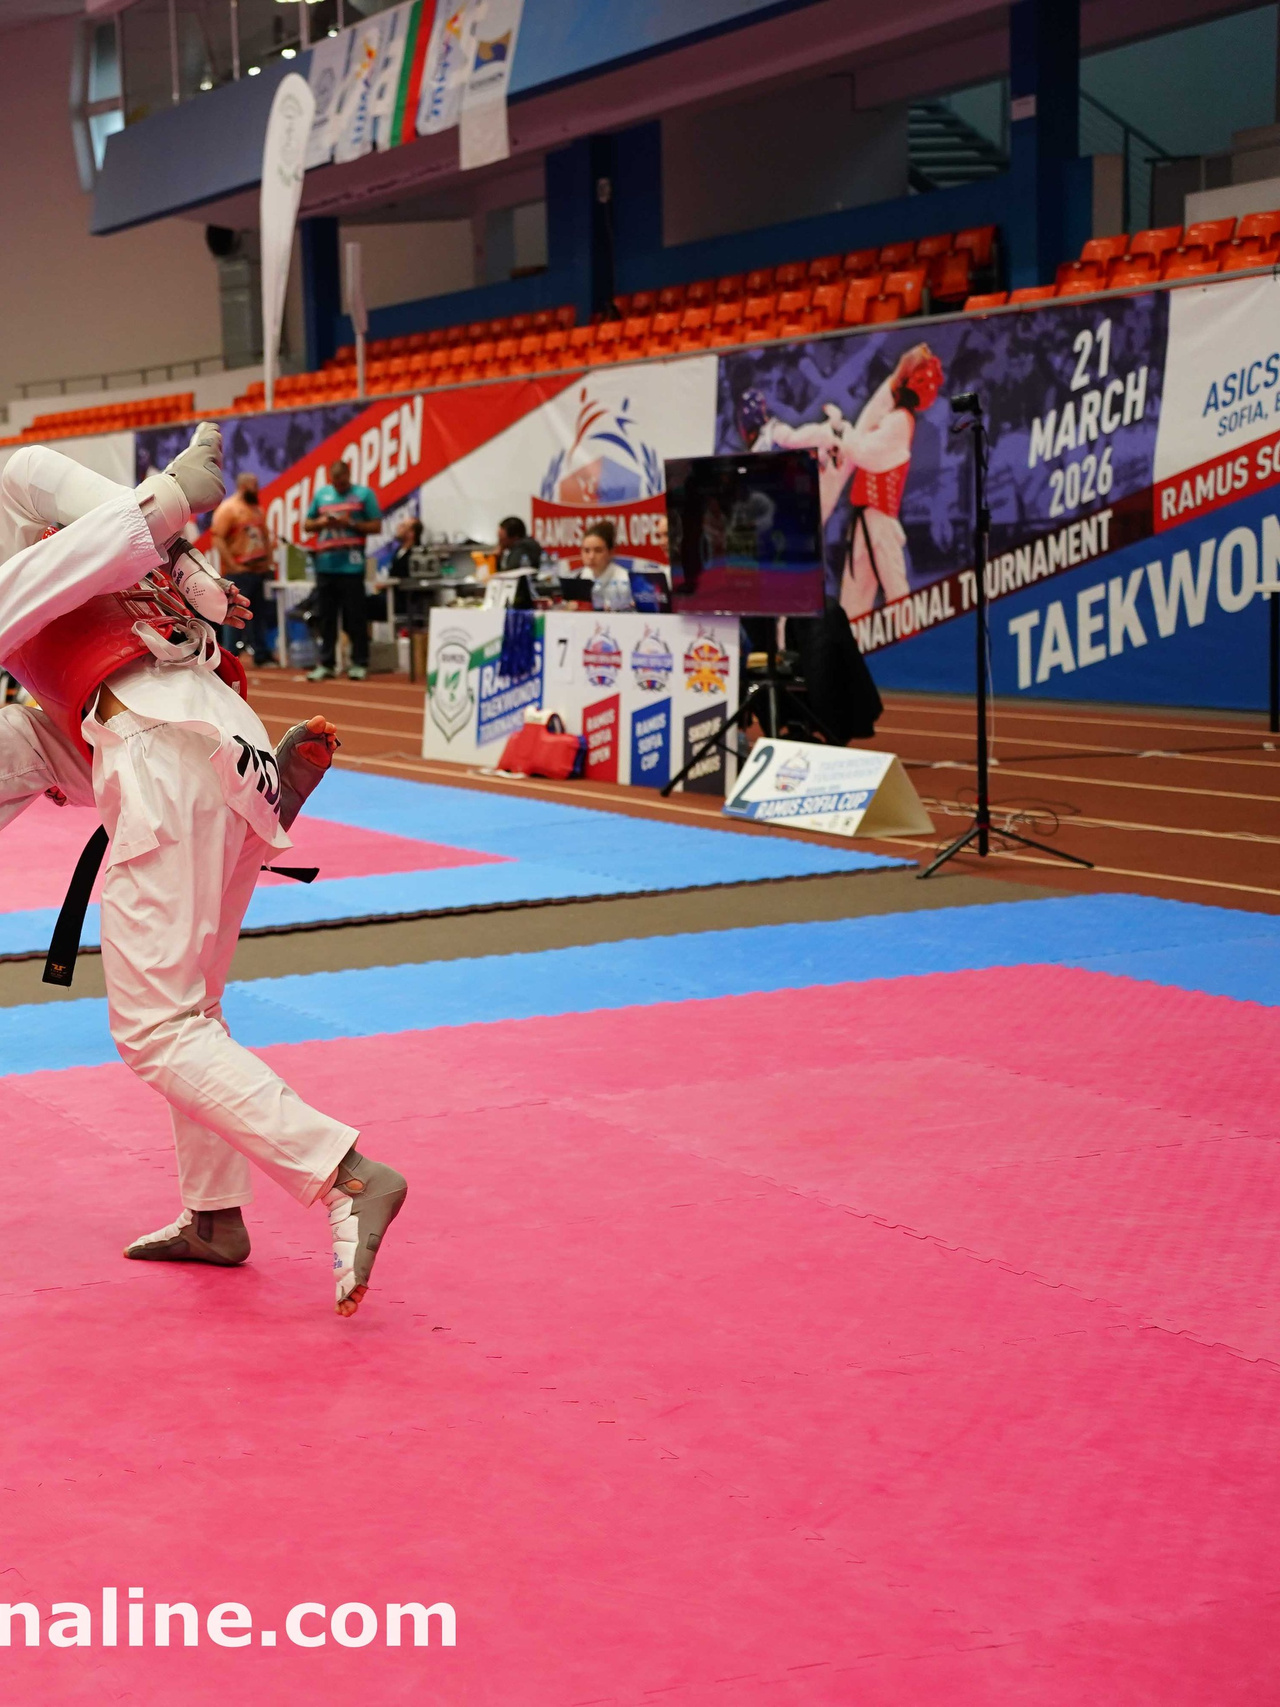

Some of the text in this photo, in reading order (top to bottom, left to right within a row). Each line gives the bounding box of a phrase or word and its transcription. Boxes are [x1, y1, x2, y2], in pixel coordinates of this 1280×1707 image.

[1071, 318, 1112, 392] 21
[1202, 352, 1280, 418] ASICS
[341, 394, 424, 488] OPEN
[1029, 366, 1148, 469] MARCH
[1217, 400, 1269, 438] SOFIA,
[1049, 447, 1113, 519] 2026
[1161, 455, 1249, 521] RAMUS
[629, 513, 662, 547] OPE
[850, 580, 956, 655] NATIONAL
[558, 639, 568, 668] 7
[730, 745, 774, 810] 2
[754, 791, 869, 821] RAMUS SOFIA CUP
